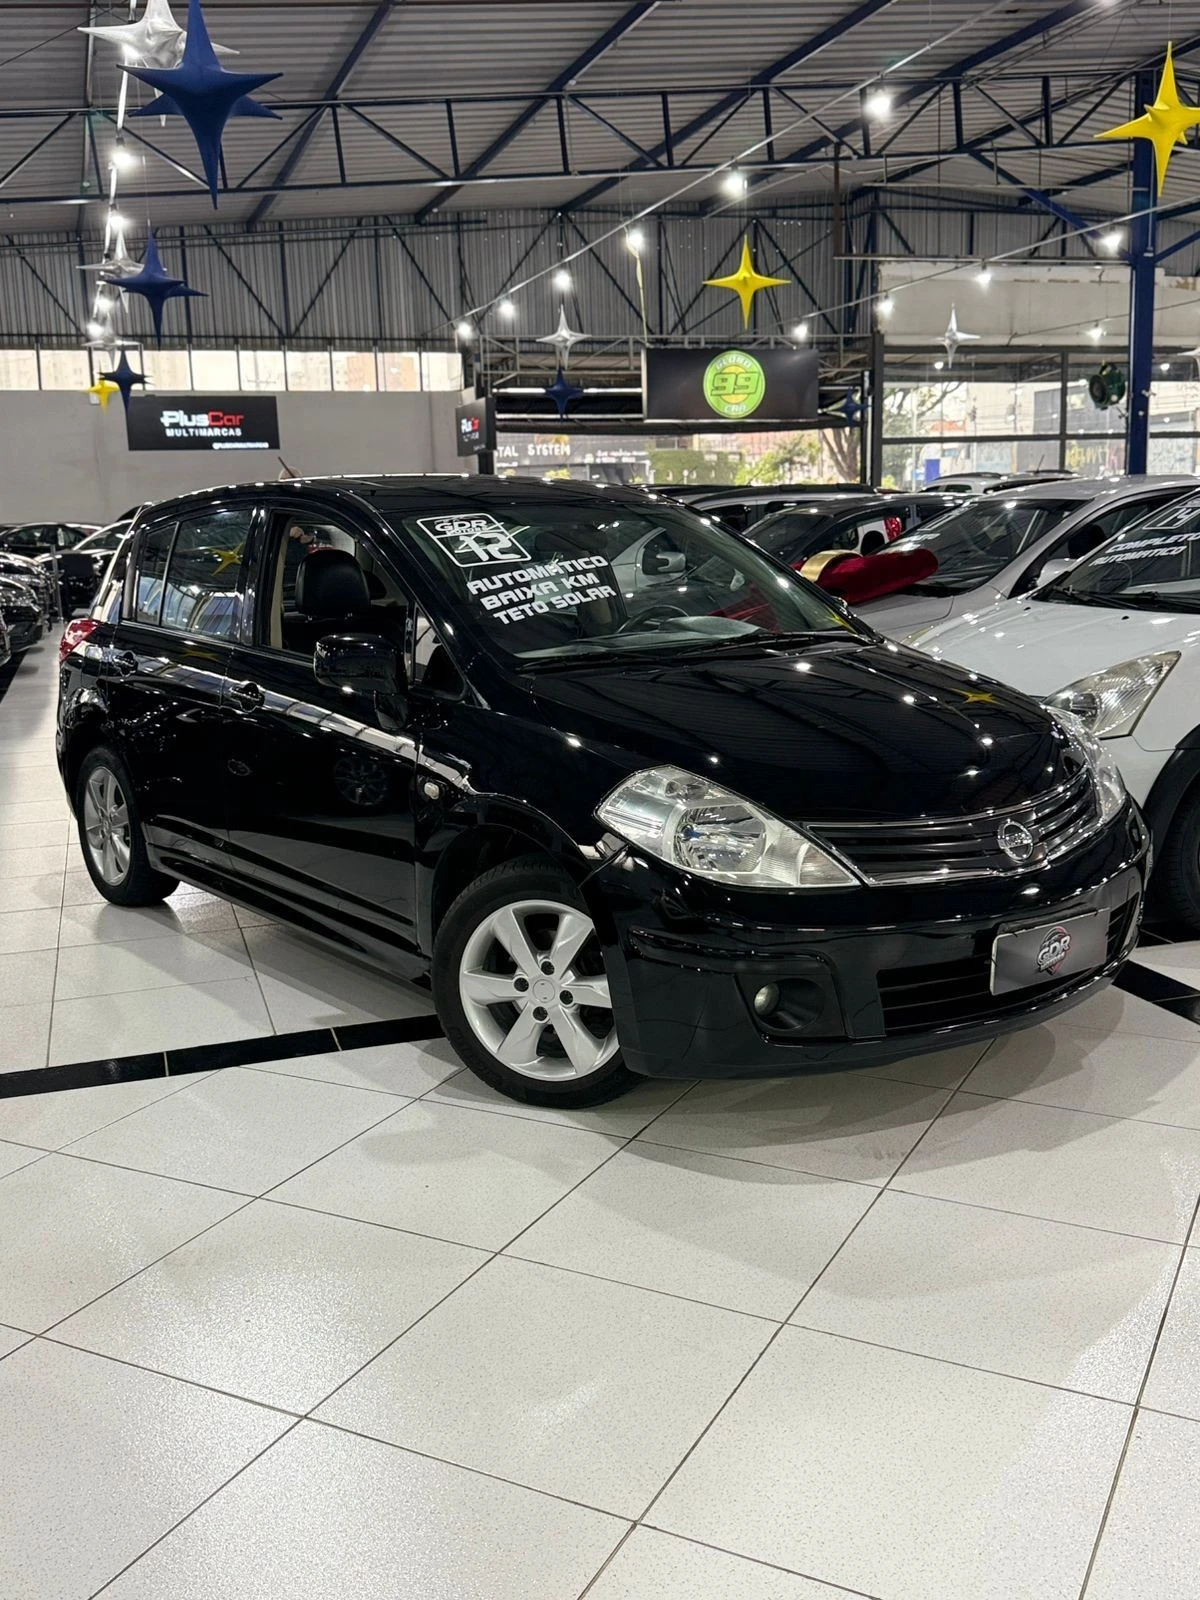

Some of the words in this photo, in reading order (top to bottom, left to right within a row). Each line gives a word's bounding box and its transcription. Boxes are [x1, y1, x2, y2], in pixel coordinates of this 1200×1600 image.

[711, 372, 760, 396] 99
[160, 410, 244, 427] PlusCar
[165, 428, 242, 437] MULTIMARCAS
[527, 443, 571, 456] SYSTEM
[434, 519, 488, 532] GDR
[1156, 508, 1200, 527] 14
[459, 532, 522, 562] 12
[1105, 532, 1200, 553] COMPLETO
[480, 580, 559, 611] BAIXA
[560, 572, 600, 589] KM
[493, 600, 550, 625] TETO
[550, 585, 617, 609] SOLAR
